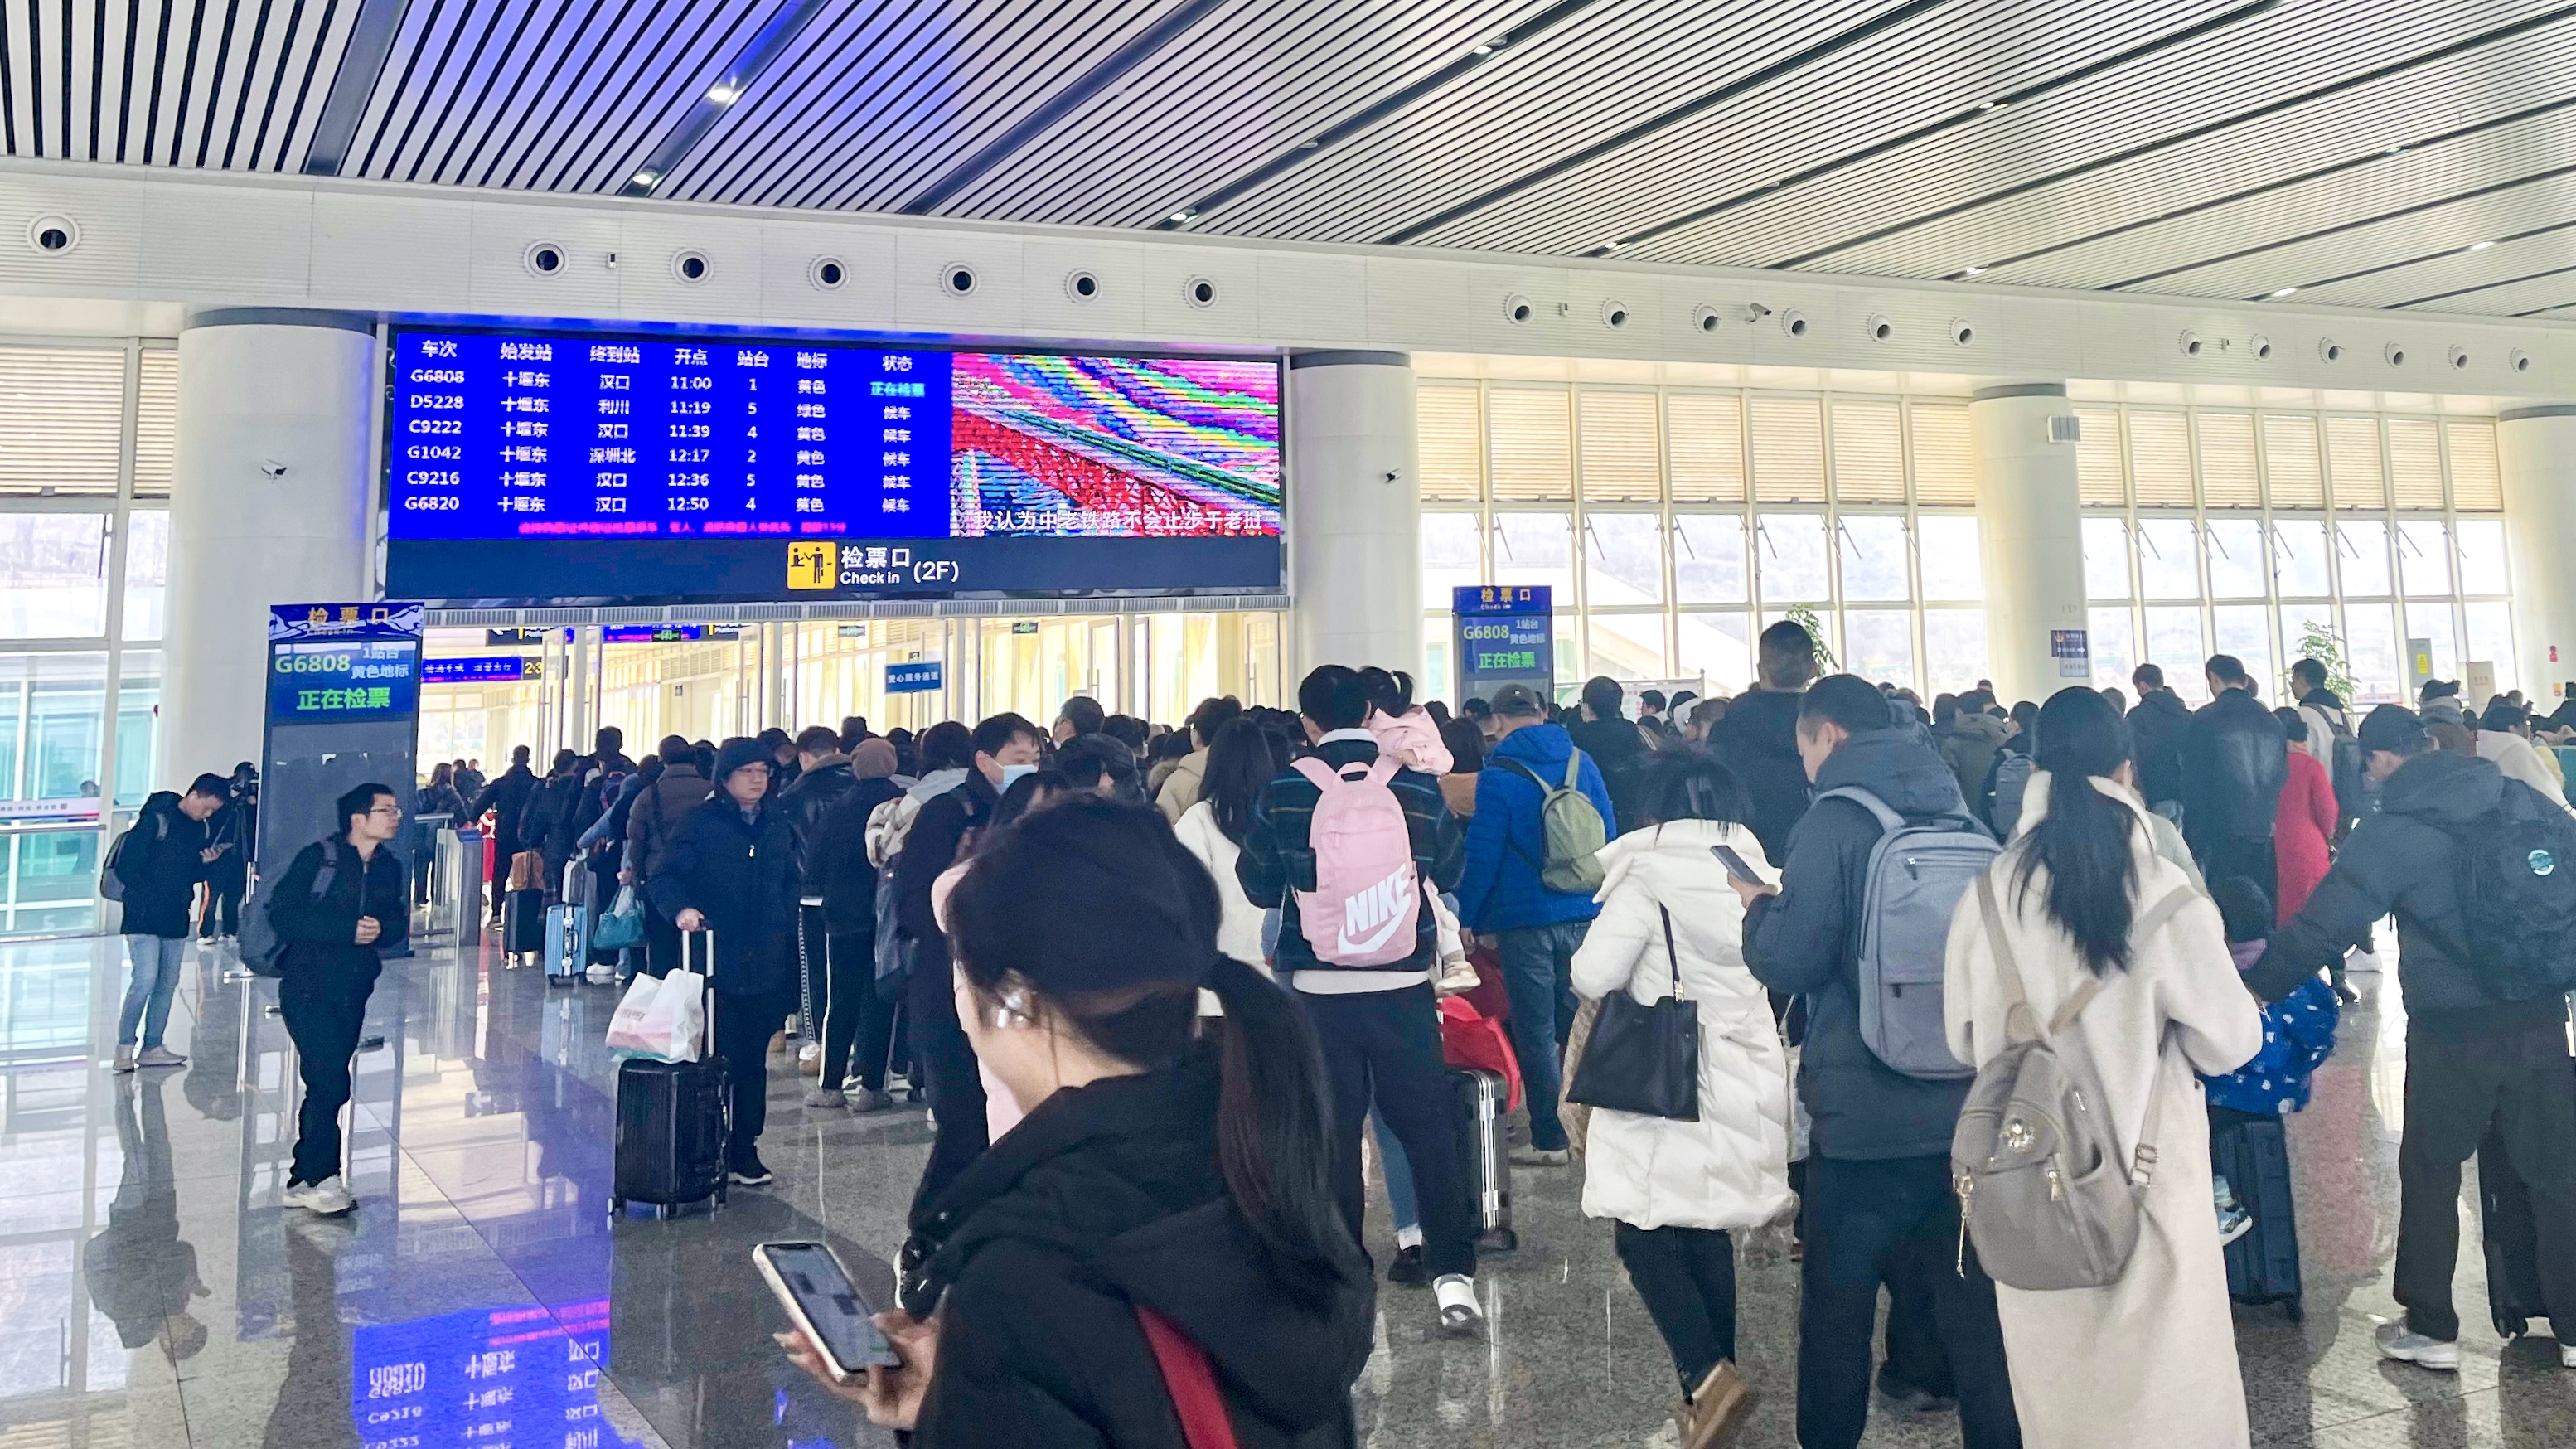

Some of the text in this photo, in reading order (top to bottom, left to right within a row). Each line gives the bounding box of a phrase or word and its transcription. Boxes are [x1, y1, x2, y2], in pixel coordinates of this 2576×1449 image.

[421, 340, 912, 371] 车次 始发站 终到站 开点 站台 地标 状态
[410, 369, 926, 397] G6808 十堰东 汉口 11:00 1 黄色 正在检票
[410, 395, 912, 420] D5228 十堰东 利川 11:19 5 绿色 候车
[409, 419, 912, 443] C9222 十堰东 汉口 11:39 4 黄色 候车
[407, 445, 911, 467] G1042 十堰东 深圳北 12:17 2 黄色 候车
[406, 471, 912, 490] C9216 十堰东 汉口 12:36 5 黄色 候车
[404, 496, 911, 513] G6820 十堰东 汉口 12:50 4 黄色 候车
[972, 510, 1262, 531] 我认为中老铁路不会止步于老挝
[840, 546, 910, 569] 检票口
[840, 571, 900, 584] Check in
[913, 561, 959, 583] (2F)
[1481, 587, 1531, 603] 检票口
[308, 606, 389, 625] 检票口
[1516, 619, 1538, 629] 1站台
[1463, 625, 1509, 640] G6808
[1510, 633, 1546, 644] 黄色地标
[362, 647, 400, 660] 1站台
[1478, 651, 1536, 669] 正在检票
[275, 654, 351, 673] G6808
[351, 664, 409, 679] 黄色地标
[296, 686, 391, 710] 正在检票
[1344, 862, 1411, 937] NIKE
